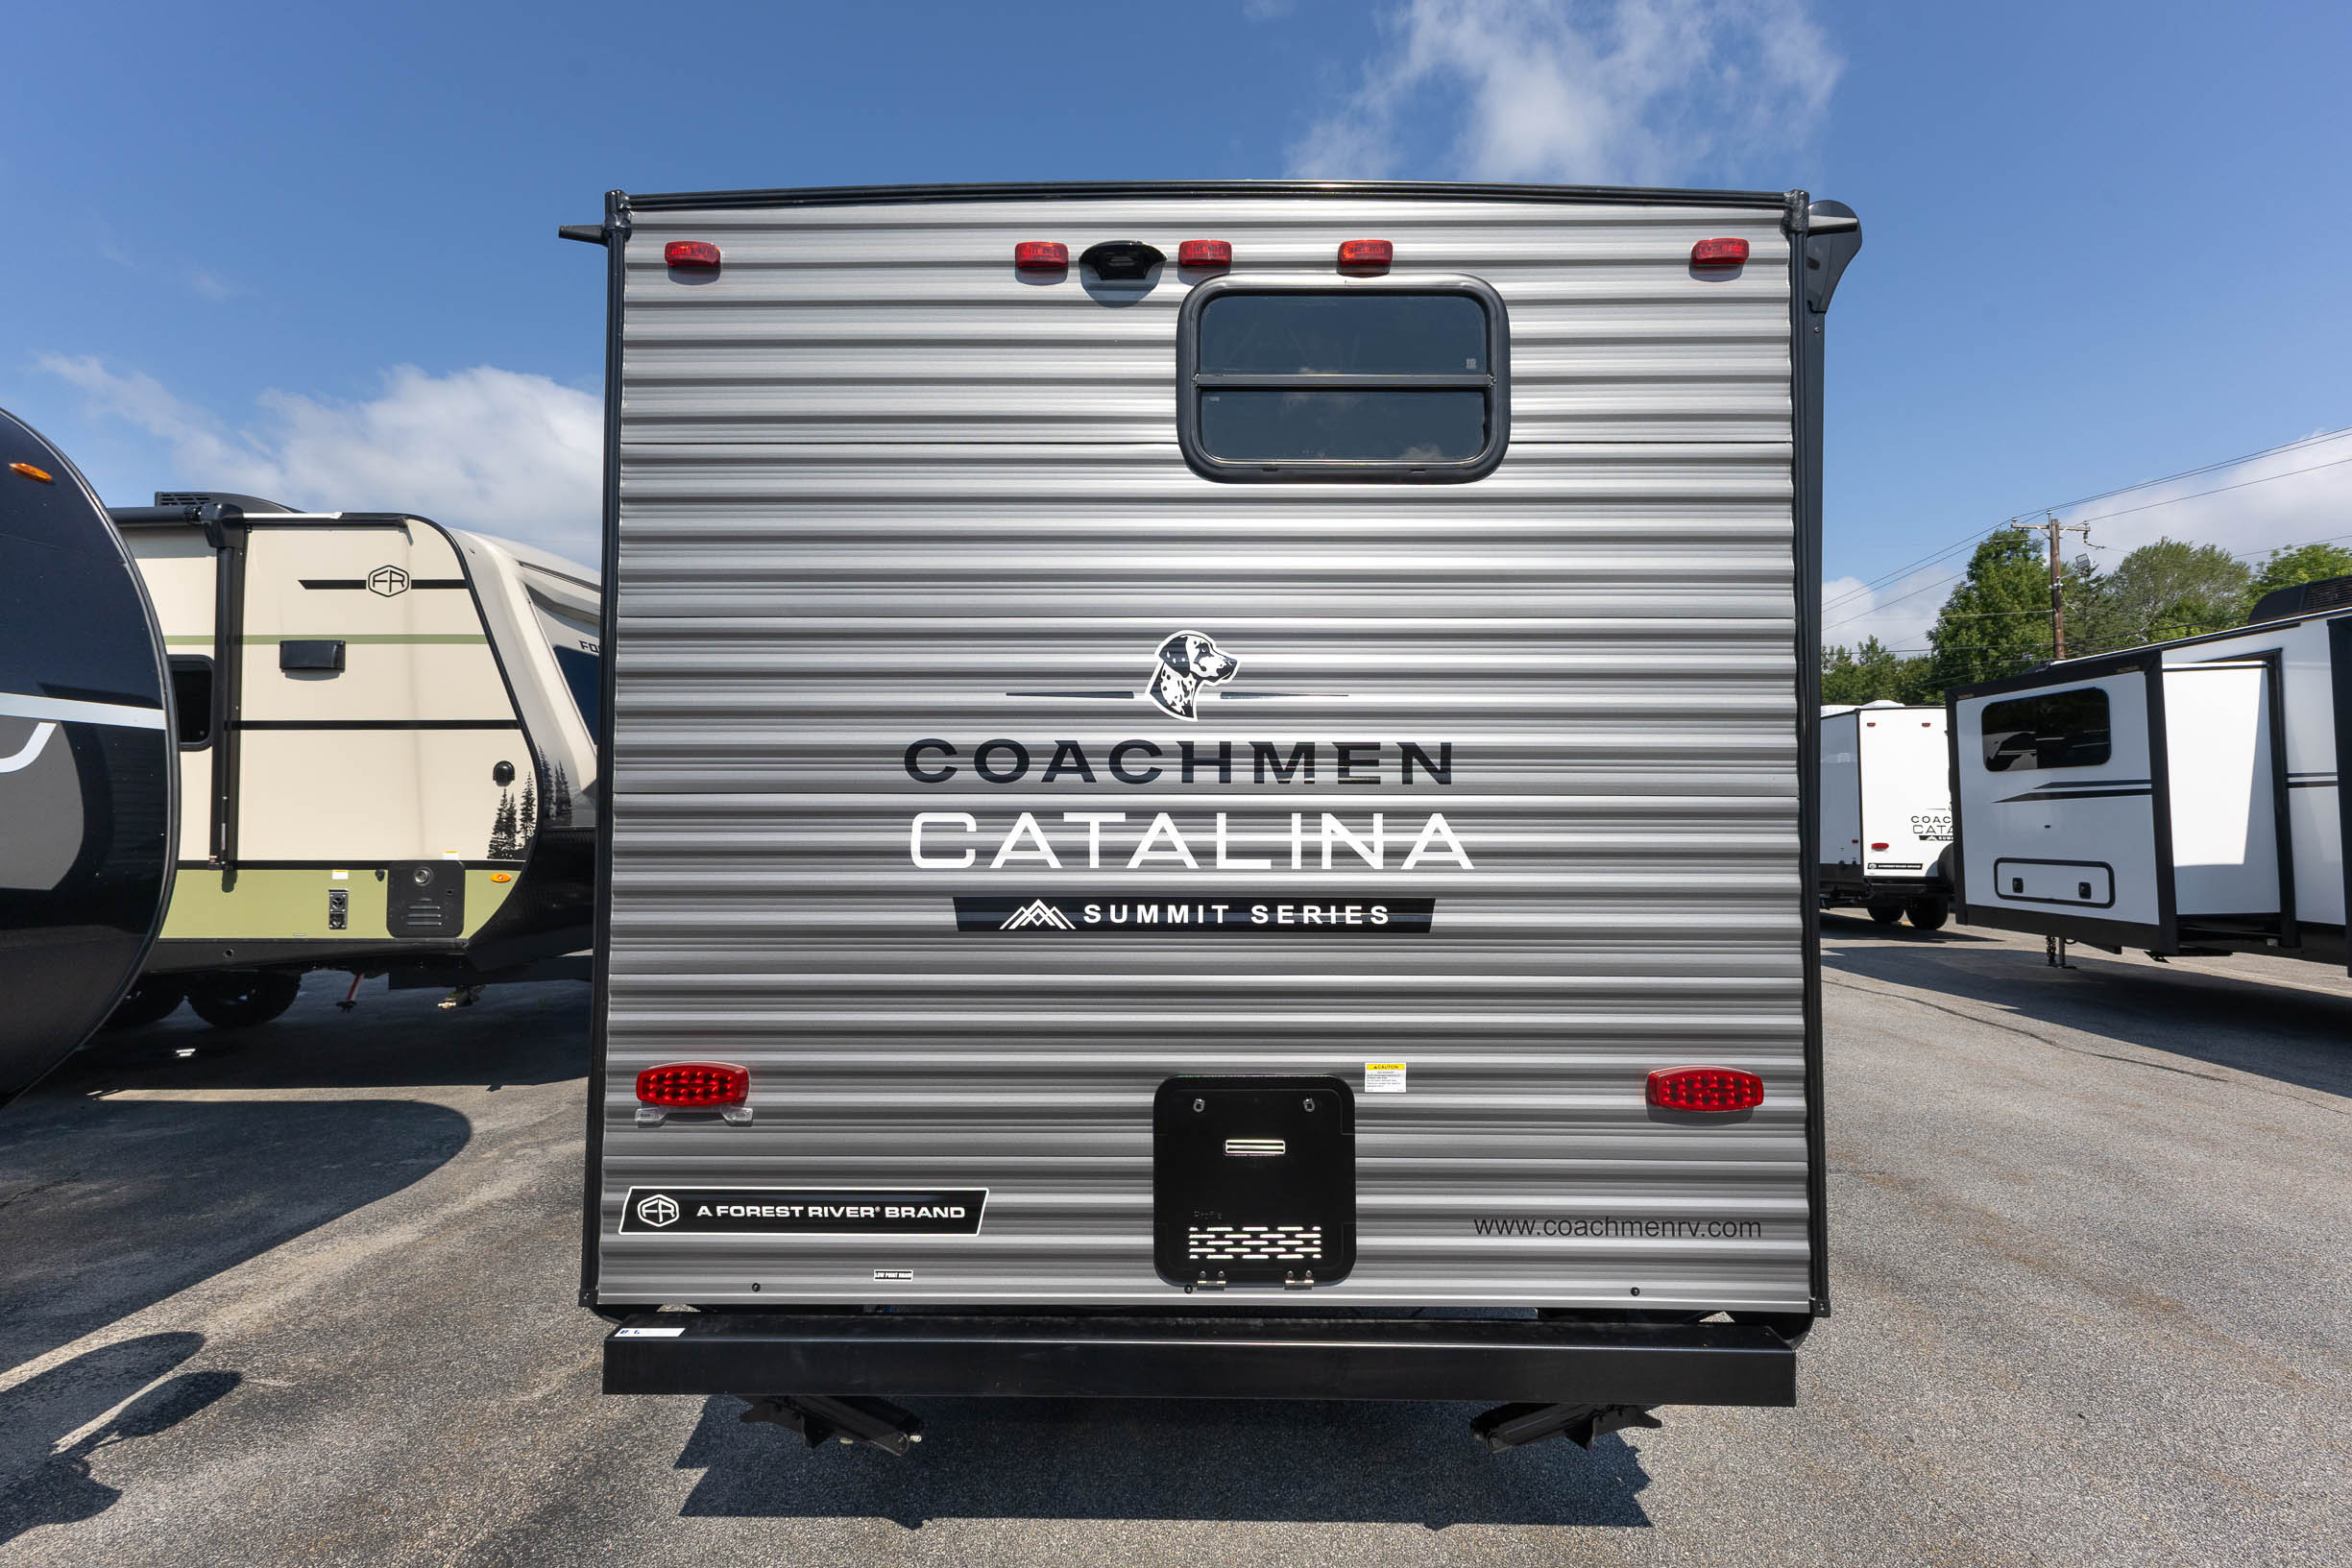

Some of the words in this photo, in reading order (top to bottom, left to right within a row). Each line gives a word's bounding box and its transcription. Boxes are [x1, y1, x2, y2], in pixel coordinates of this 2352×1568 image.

[578, 639, 600, 653] FO
[904, 737, 1452, 784] COACHMEN
[1911, 815, 1952, 824] COAC
[1912, 824, 1953, 834] CATA
[910, 812, 1476, 870] CATALINA
[1083, 905, 1229, 924] SUMMIT
[1250, 905, 1390, 924] SERIES
[696, 1205, 713, 1217] A
[716, 1205, 804, 1218] FOREST
[885, 1206, 966, 1218] BRAND
[1473, 1216, 1761, 1238] www.coachmenrv.com
